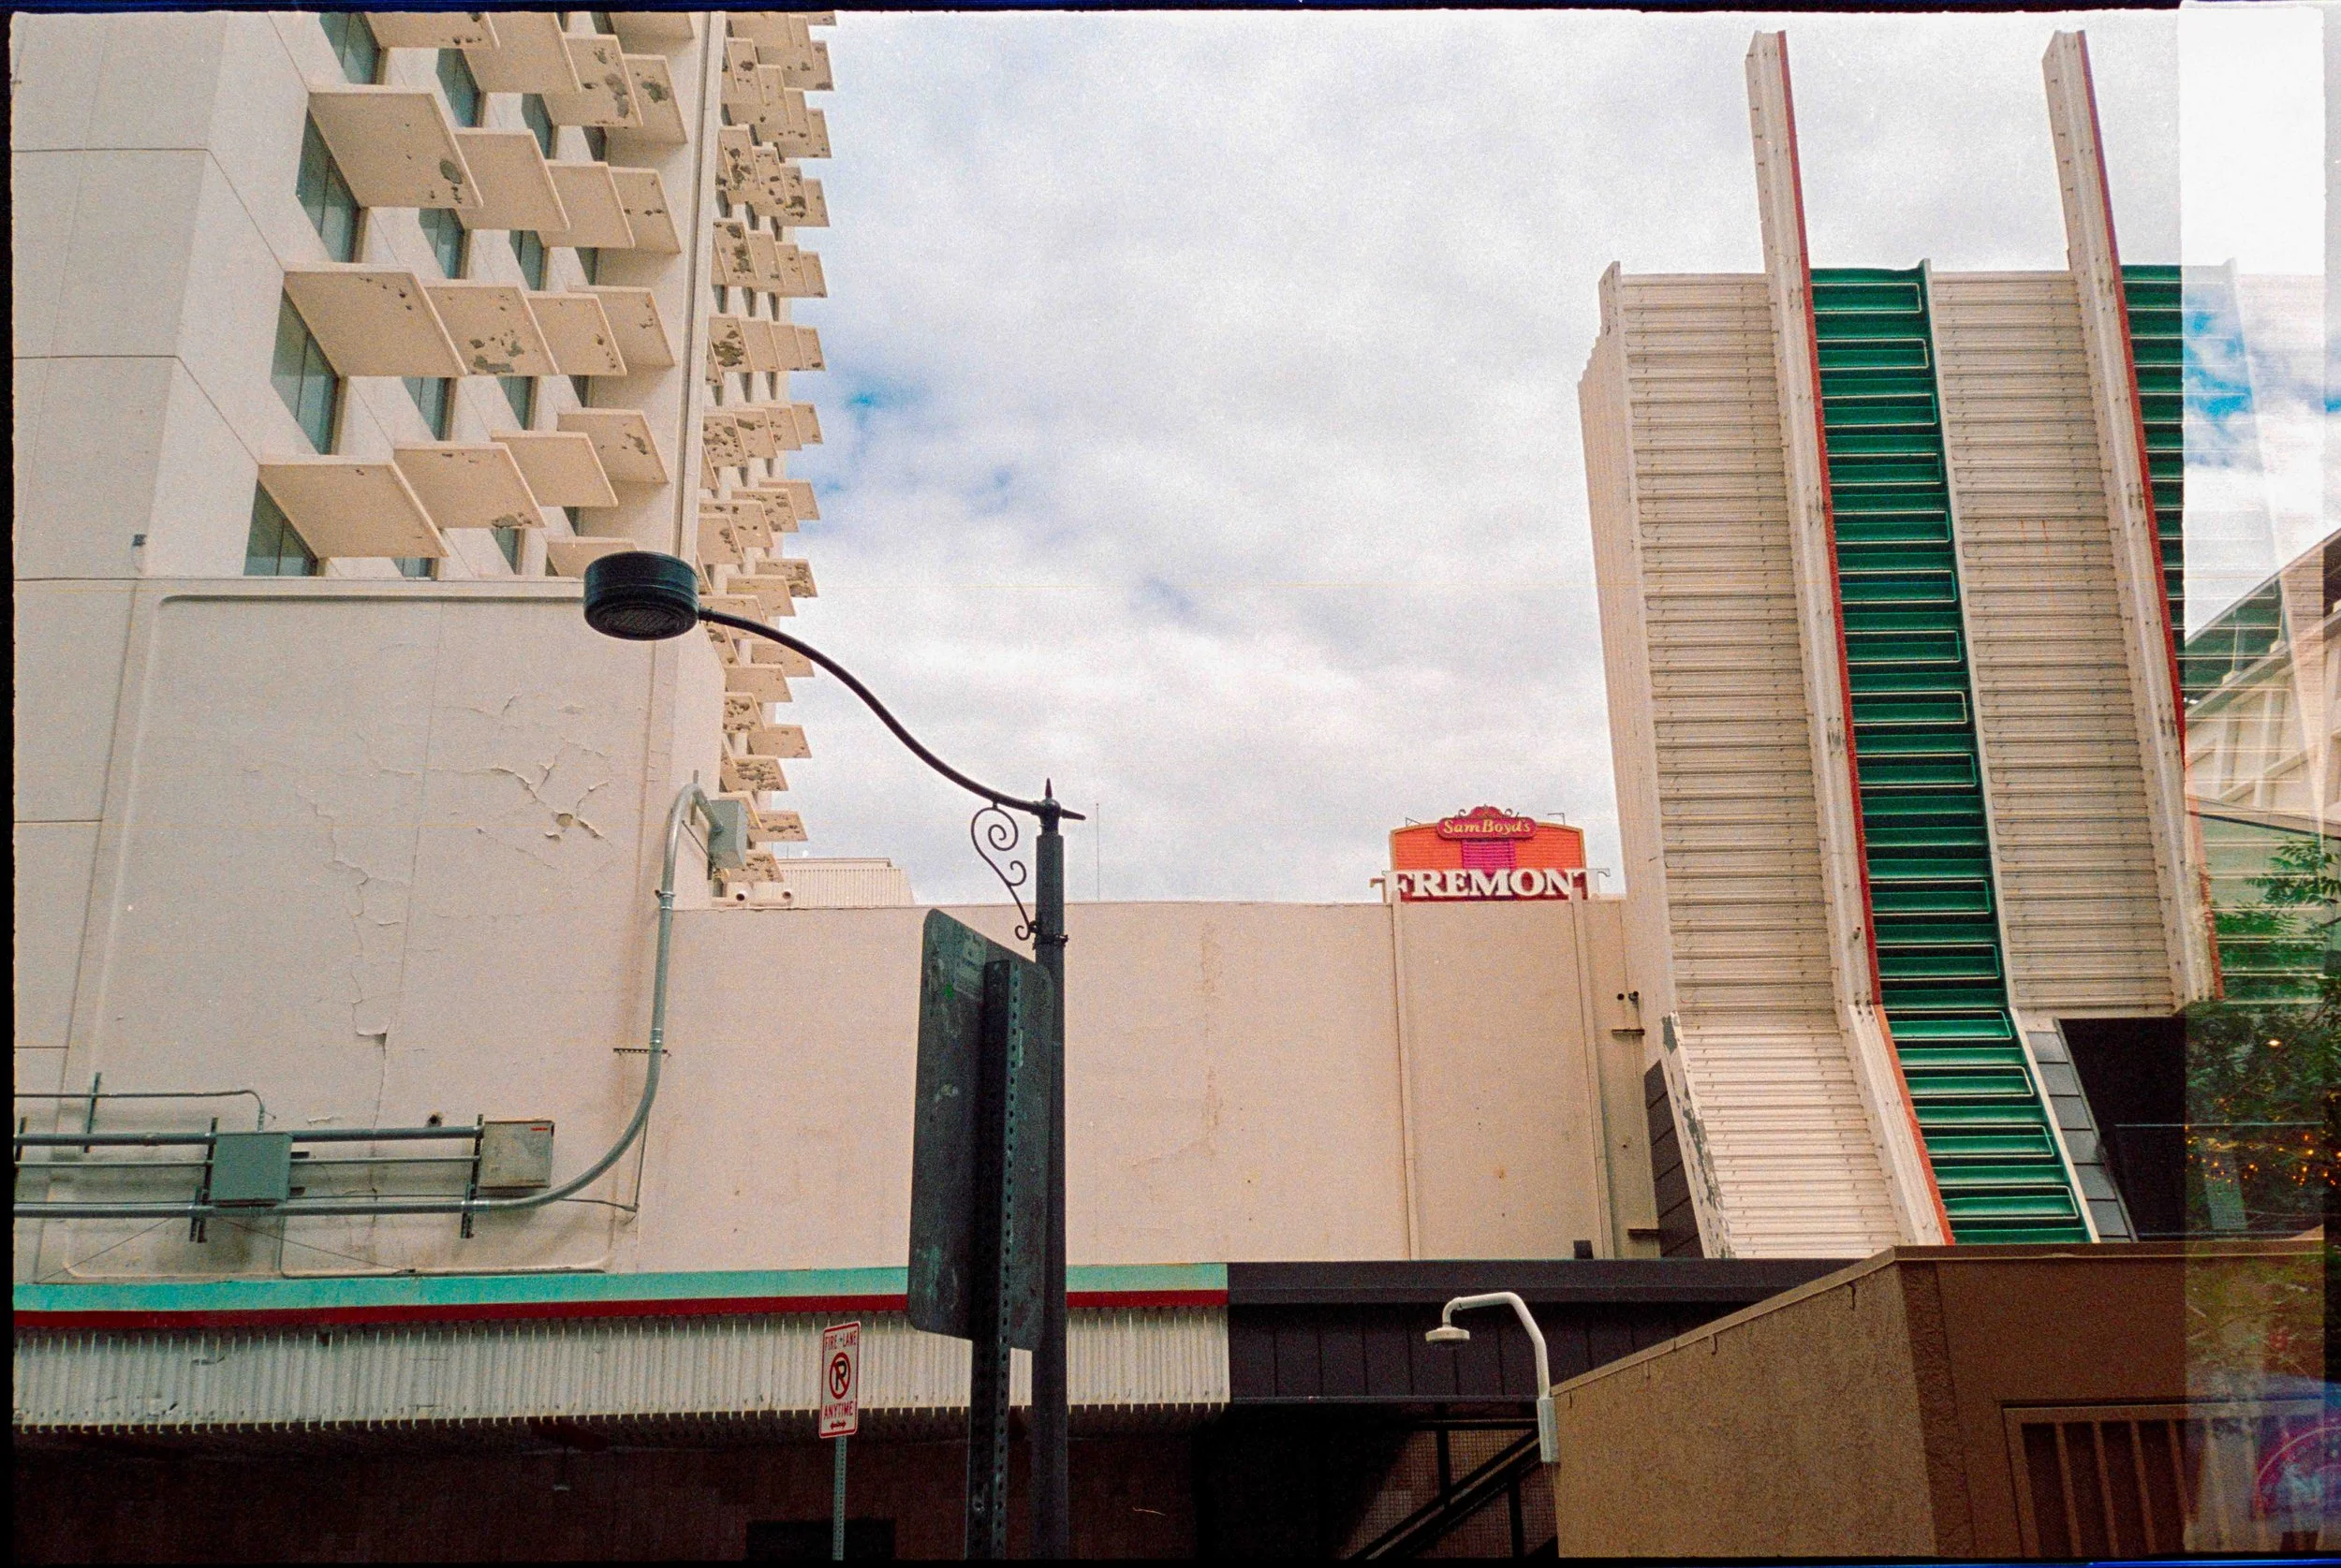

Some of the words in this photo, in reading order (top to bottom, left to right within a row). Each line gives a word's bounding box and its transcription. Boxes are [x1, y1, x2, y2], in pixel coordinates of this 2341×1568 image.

[1443, 820, 1481, 834] Sam
[1482, 819, 1532, 835] Boyd's
[1381, 868, 1611, 900] FREMONT
[824, 1334, 837, 1351] FIRE
[842, 1330, 857, 1347] LANE
[823, 1401, 853, 1419] ANYTIME
